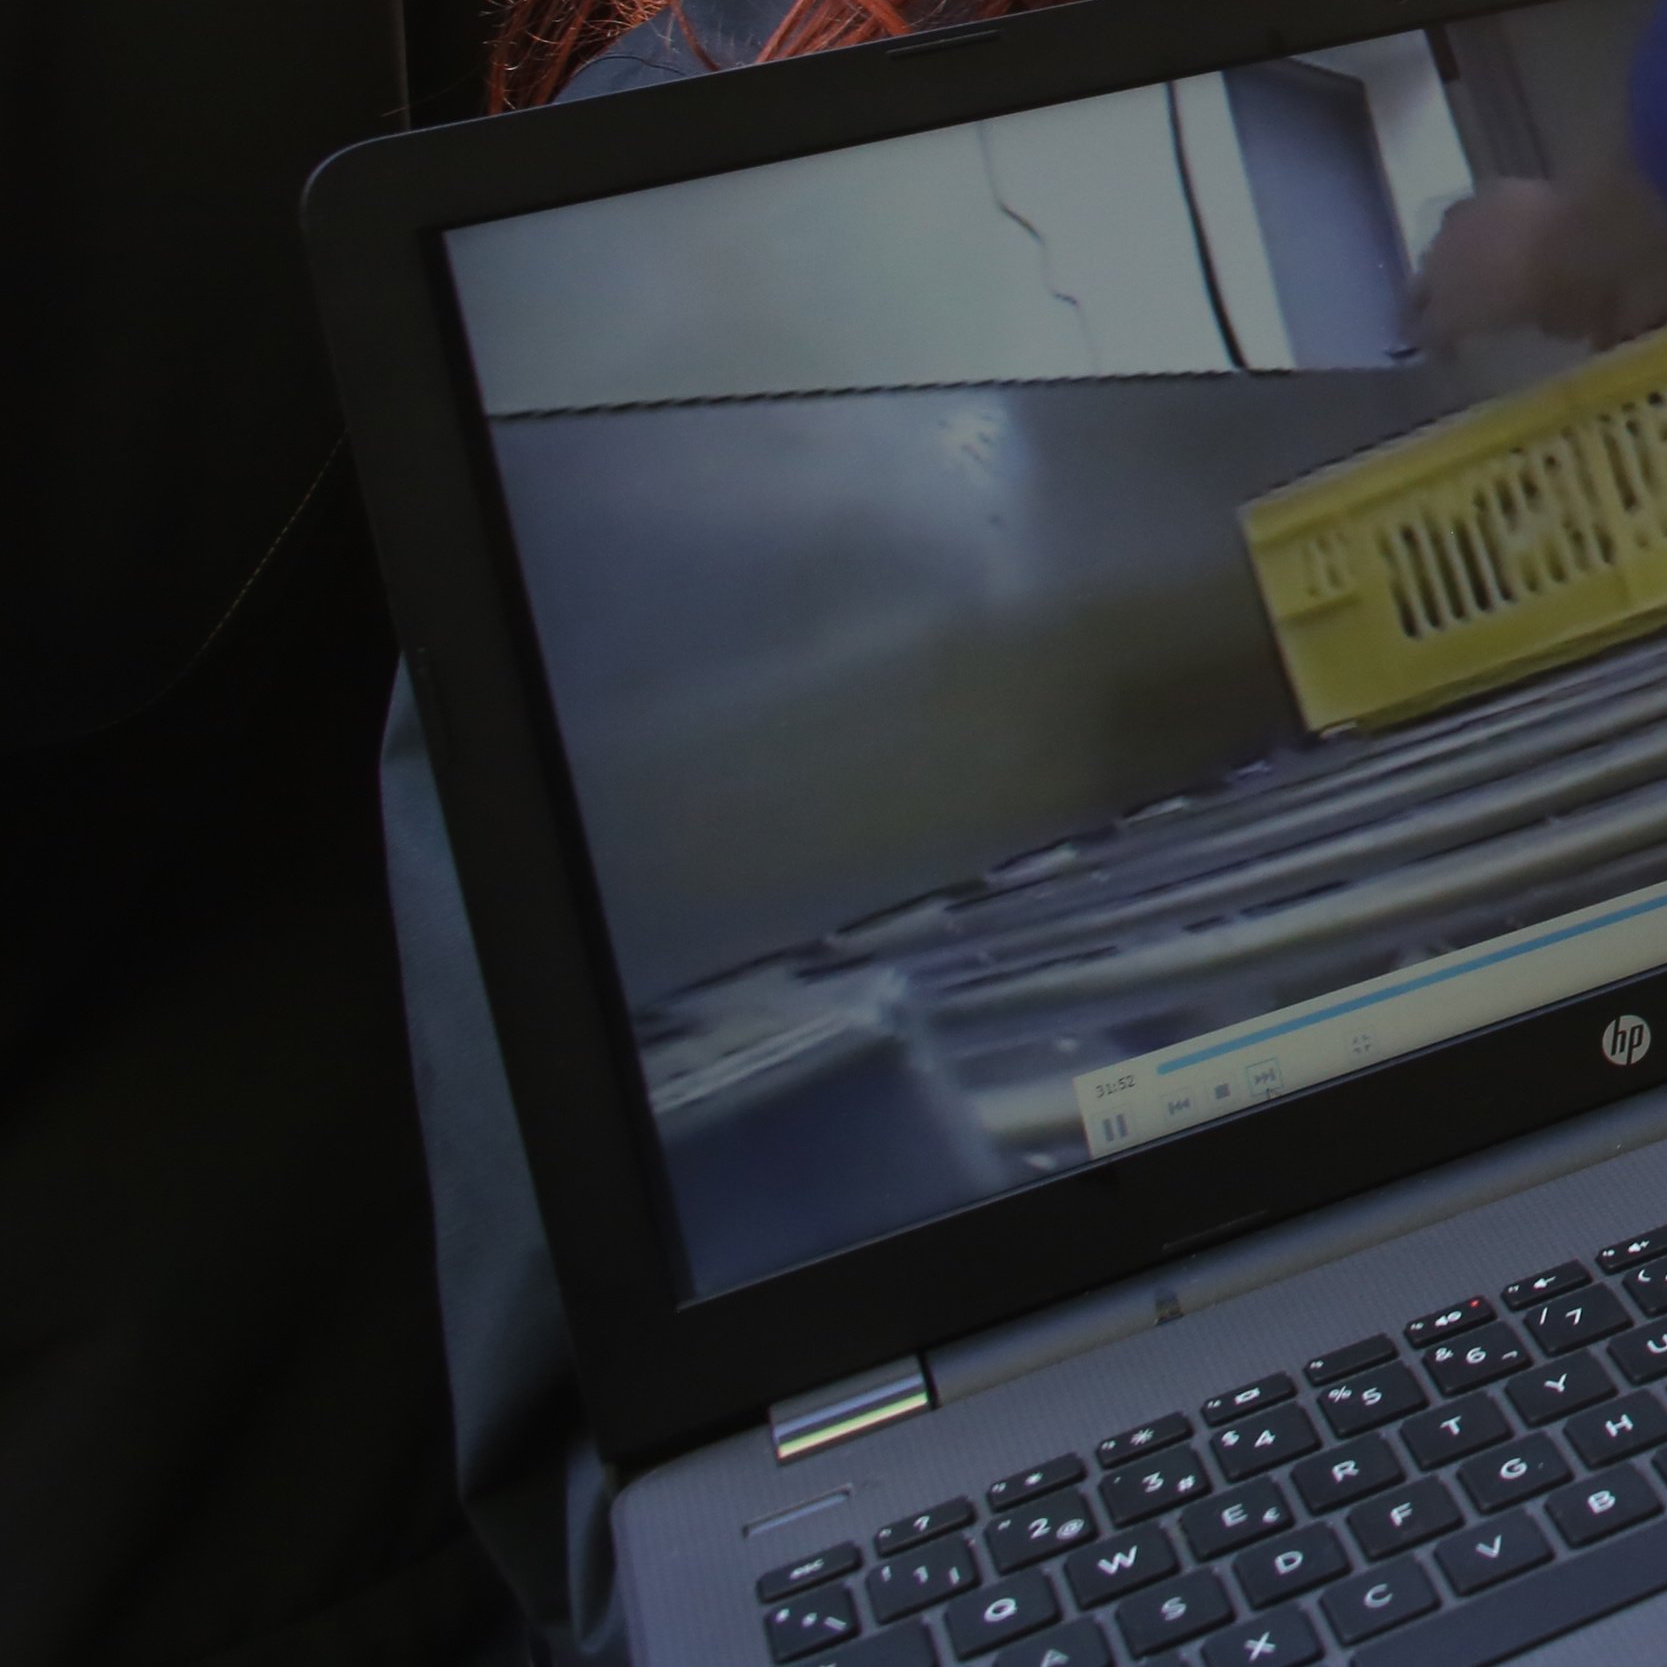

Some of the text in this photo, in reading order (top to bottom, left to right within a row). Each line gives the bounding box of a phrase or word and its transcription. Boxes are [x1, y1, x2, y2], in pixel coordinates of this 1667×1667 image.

[1608, 1016, 1646, 1065] hp
[1095, 1074, 1137, 1099] 31:52
[1566, 1308, 1581, 1324] 7
[1466, 1347, 1486, 1363] 6
[1545, 1374, 1566, 1392] Y
[1329, 1386, 1381, 1405] % 5
[1441, 1416, 1460, 1434] T
[1606, 1414, 1633, 1436] H
[1255, 1430, 1275, 1447] 4
[1332, 1461, 1358, 1481] R
[1500, 1458, 1527, 1479] G
[1143, 1472, 1163, 1492] 3
[1588, 1491, 1615, 1513] B
[1222, 1504, 1247, 1526] E
[1391, 1503, 1411, 1526] F
[1029, 1518, 1050, 1538] 2
[1477, 1536, 1501, 1557] V
[1098, 1546, 1137, 1574] W
[1275, 1551, 1303, 1574] D
[1364, 1584, 1392, 1607] C
[985, 1598, 1016, 1621] Q
[1162, 1597, 1186, 1620] S
[1246, 1633, 1275, 1660] X
